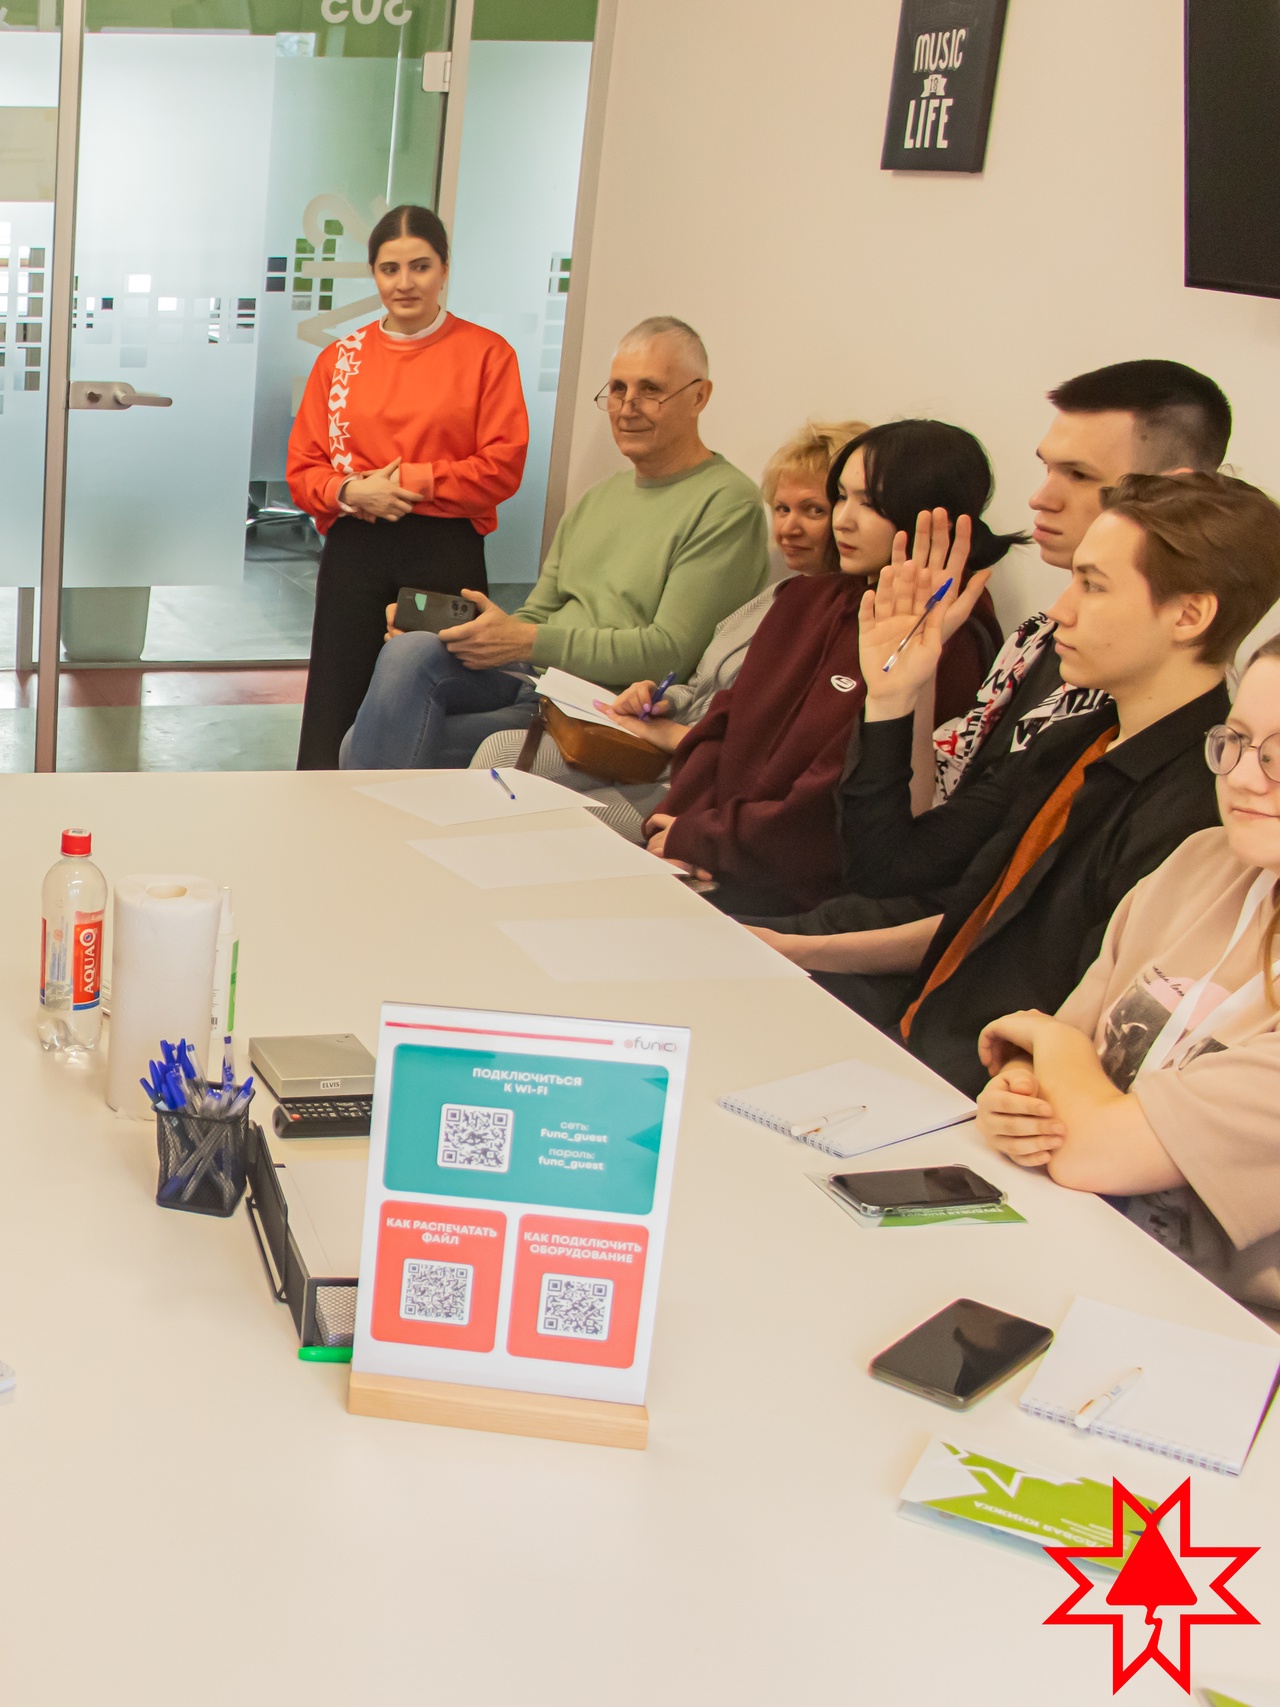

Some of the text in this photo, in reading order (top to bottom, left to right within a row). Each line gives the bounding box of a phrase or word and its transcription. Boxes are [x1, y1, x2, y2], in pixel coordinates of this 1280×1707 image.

[913, 28, 967, 73] MUSIC
[903, 98, 954, 149] LIFE
[322, 1081, 340, 1089] ELVIS
[472, 1067, 583, 1087] ПОДКЛЮЧИТЬСЯ
[515, 1084, 548, 1096] WI-FI
[560, 1121, 590, 1131] сеть:
[548, 1148, 596, 1160] пароль:
[385, 1217, 497, 1238] КАК РАСПЕЧАТАТЬ
[421, 1231, 459, 1245] ФАЙЛ
[523, 1231, 642, 1253] КАК ПОДКЛЮЧИТЬ
[529, 1243, 634, 1264] ОБОРУДОВАНИЕ
